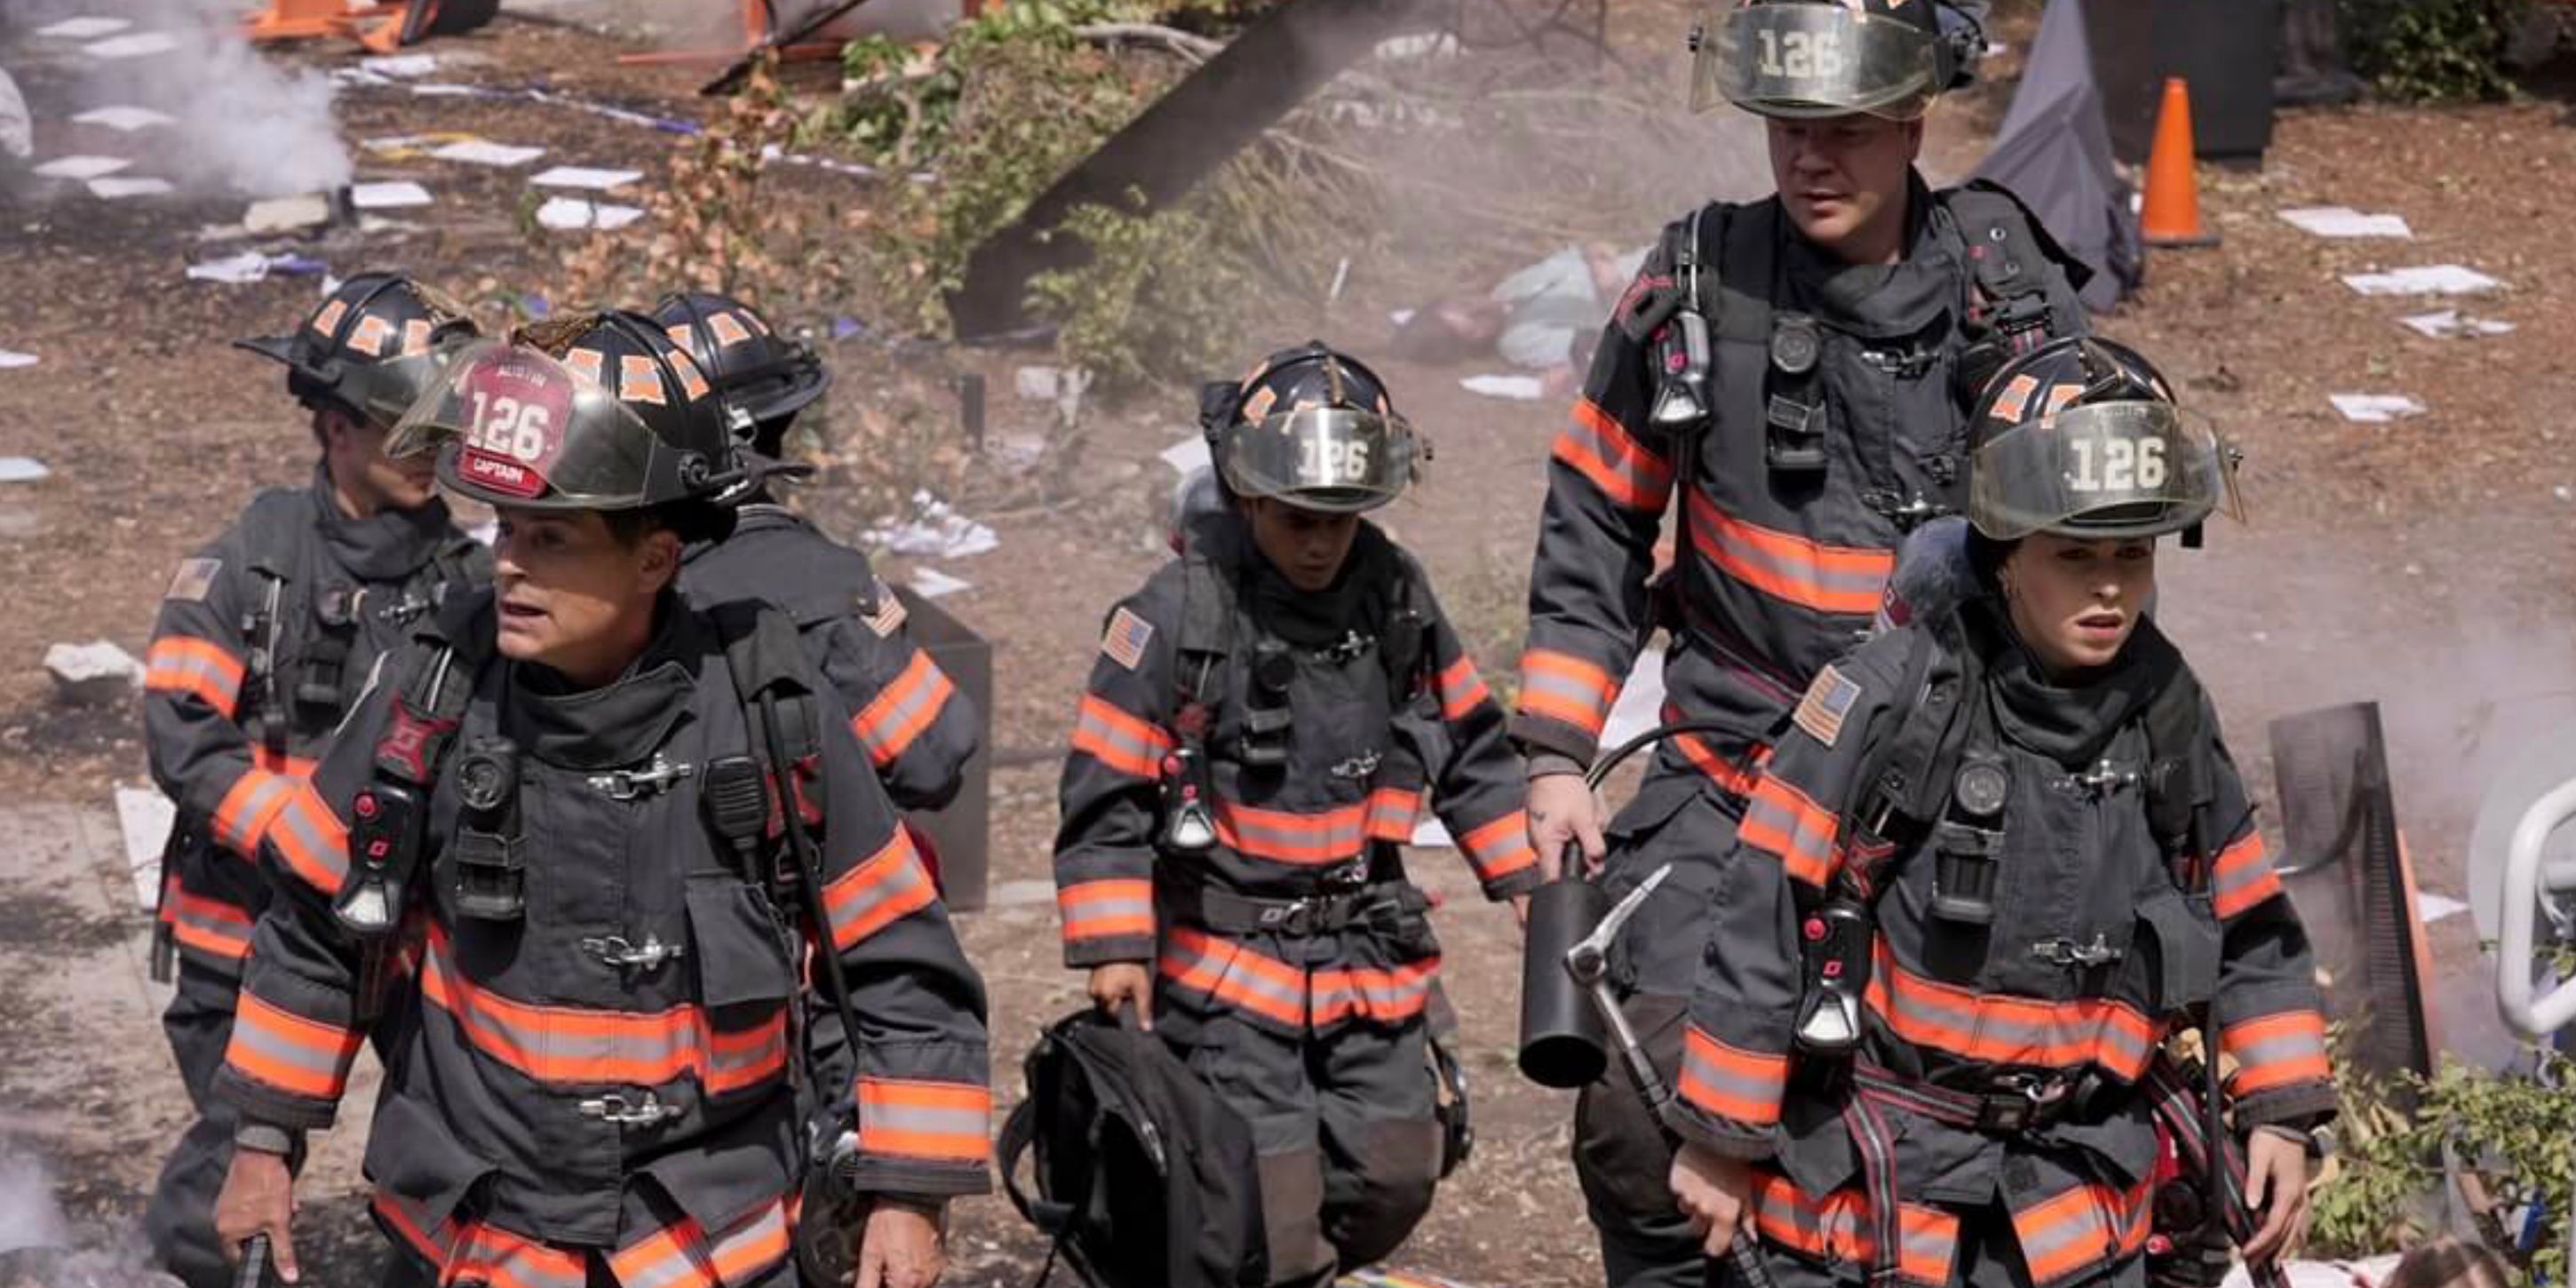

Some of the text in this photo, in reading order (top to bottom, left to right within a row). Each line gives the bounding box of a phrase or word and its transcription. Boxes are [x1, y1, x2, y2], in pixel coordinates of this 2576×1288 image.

[1759, 29, 1842, 78] 126
[467, 392, 548, 461] 126
[473, 457, 524, 483] CAPTAIN
[1298, 440, 1368, 480] 126
[2070, 437, 2165, 490] 126
